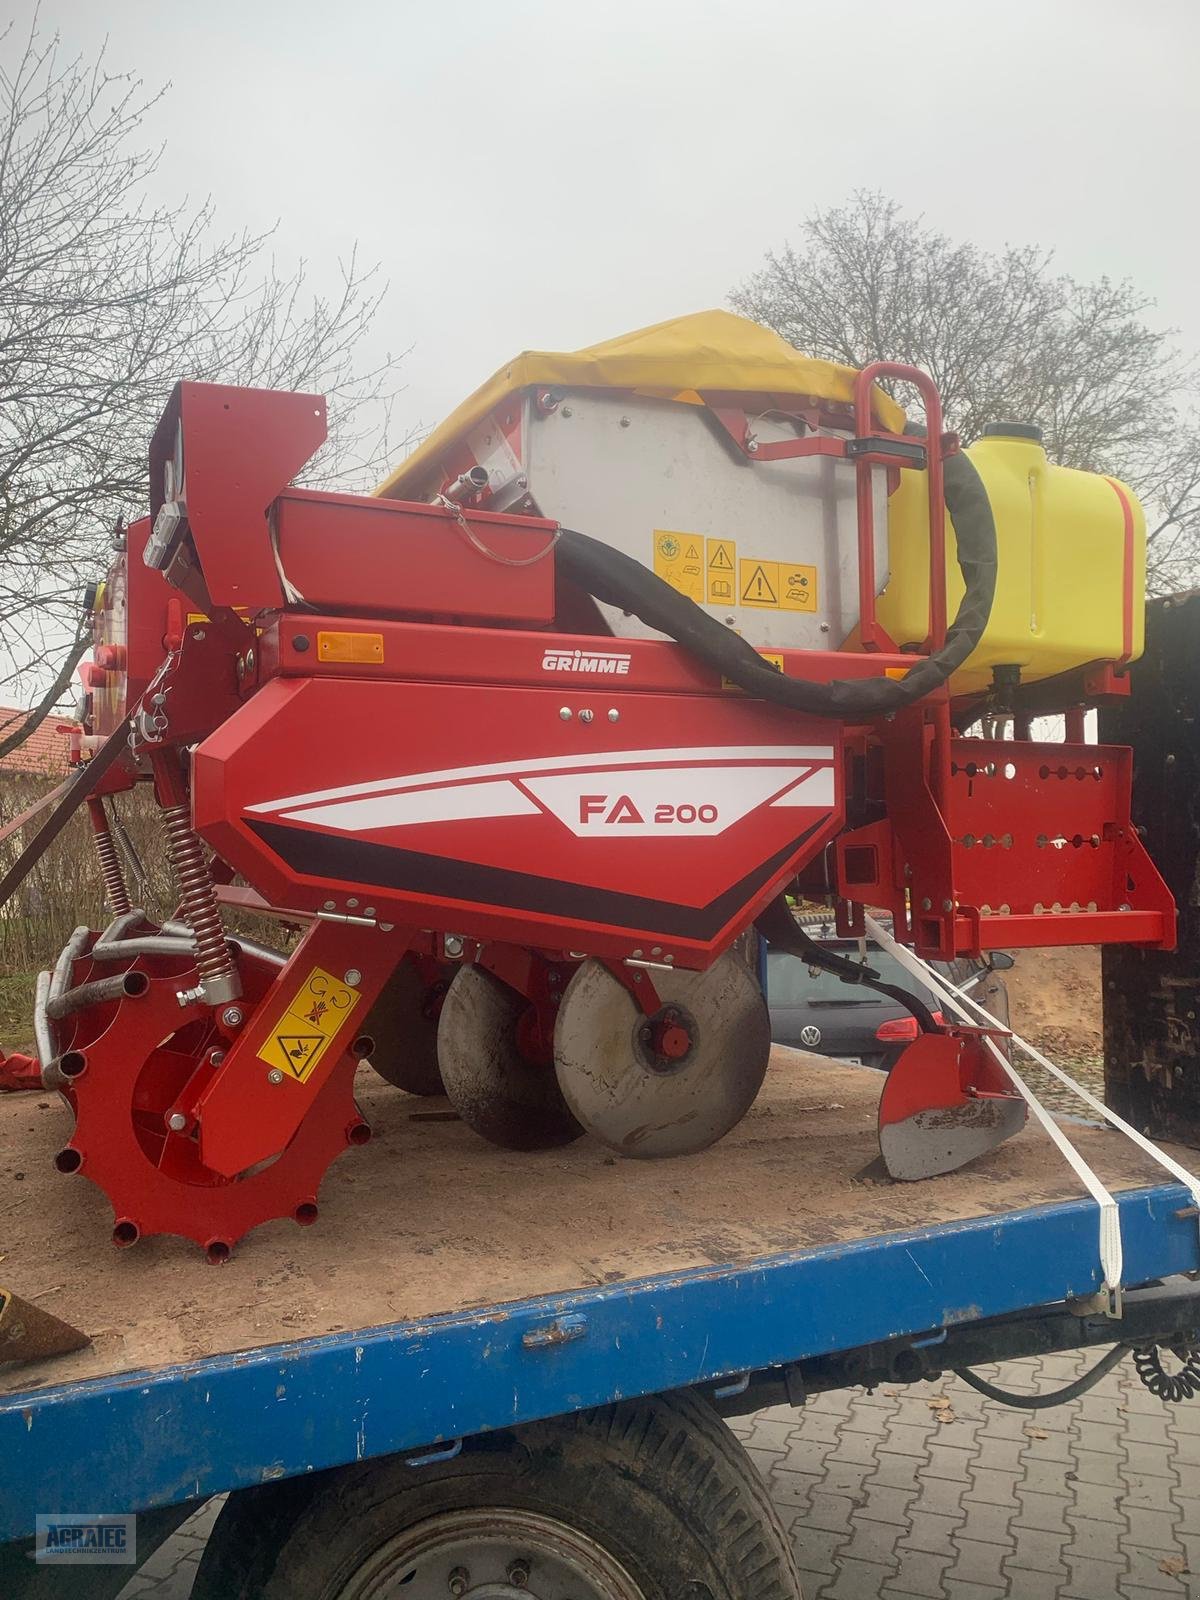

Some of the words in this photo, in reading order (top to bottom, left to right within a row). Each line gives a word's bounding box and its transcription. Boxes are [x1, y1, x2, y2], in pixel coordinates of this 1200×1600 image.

[542, 650, 631, 674] GRIMME
[579, 795, 645, 824] FA
[654, 804, 718, 824] 200
